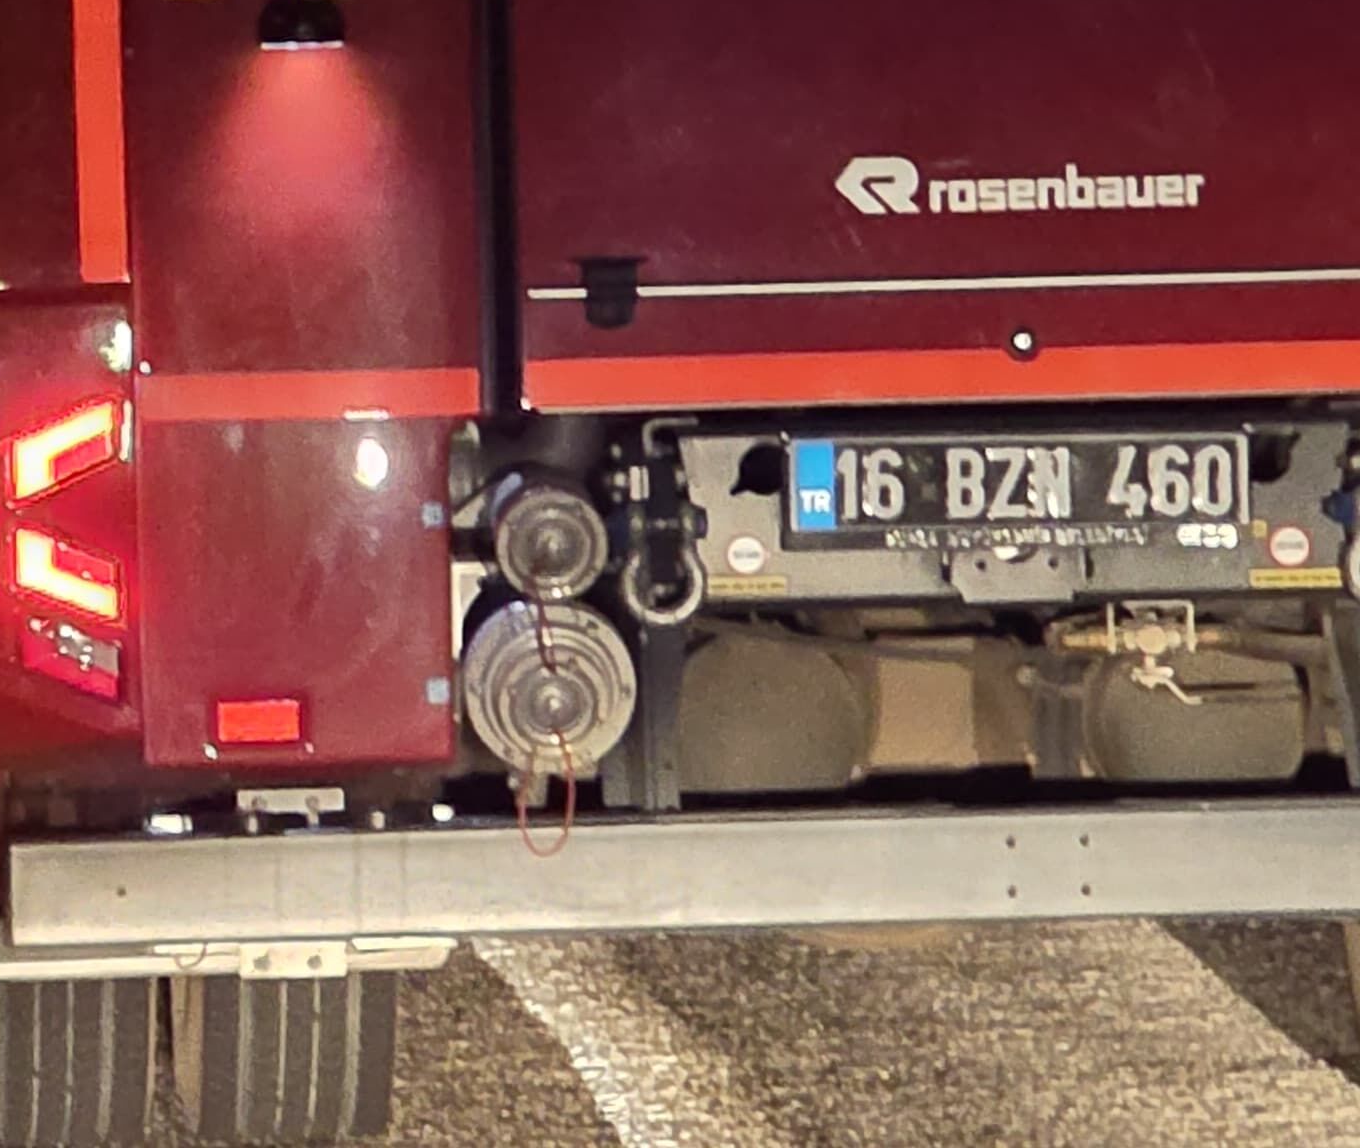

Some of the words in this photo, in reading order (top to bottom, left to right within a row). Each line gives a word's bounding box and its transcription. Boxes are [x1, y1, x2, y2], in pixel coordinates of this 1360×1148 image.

[929, 163, 1205, 213] rosenbauer
[799, 489, 831, 514] TR
[837, 447, 905, 520] 16
[945, 446, 1071, 520] BZN
[1107, 444, 1233, 518] 460
